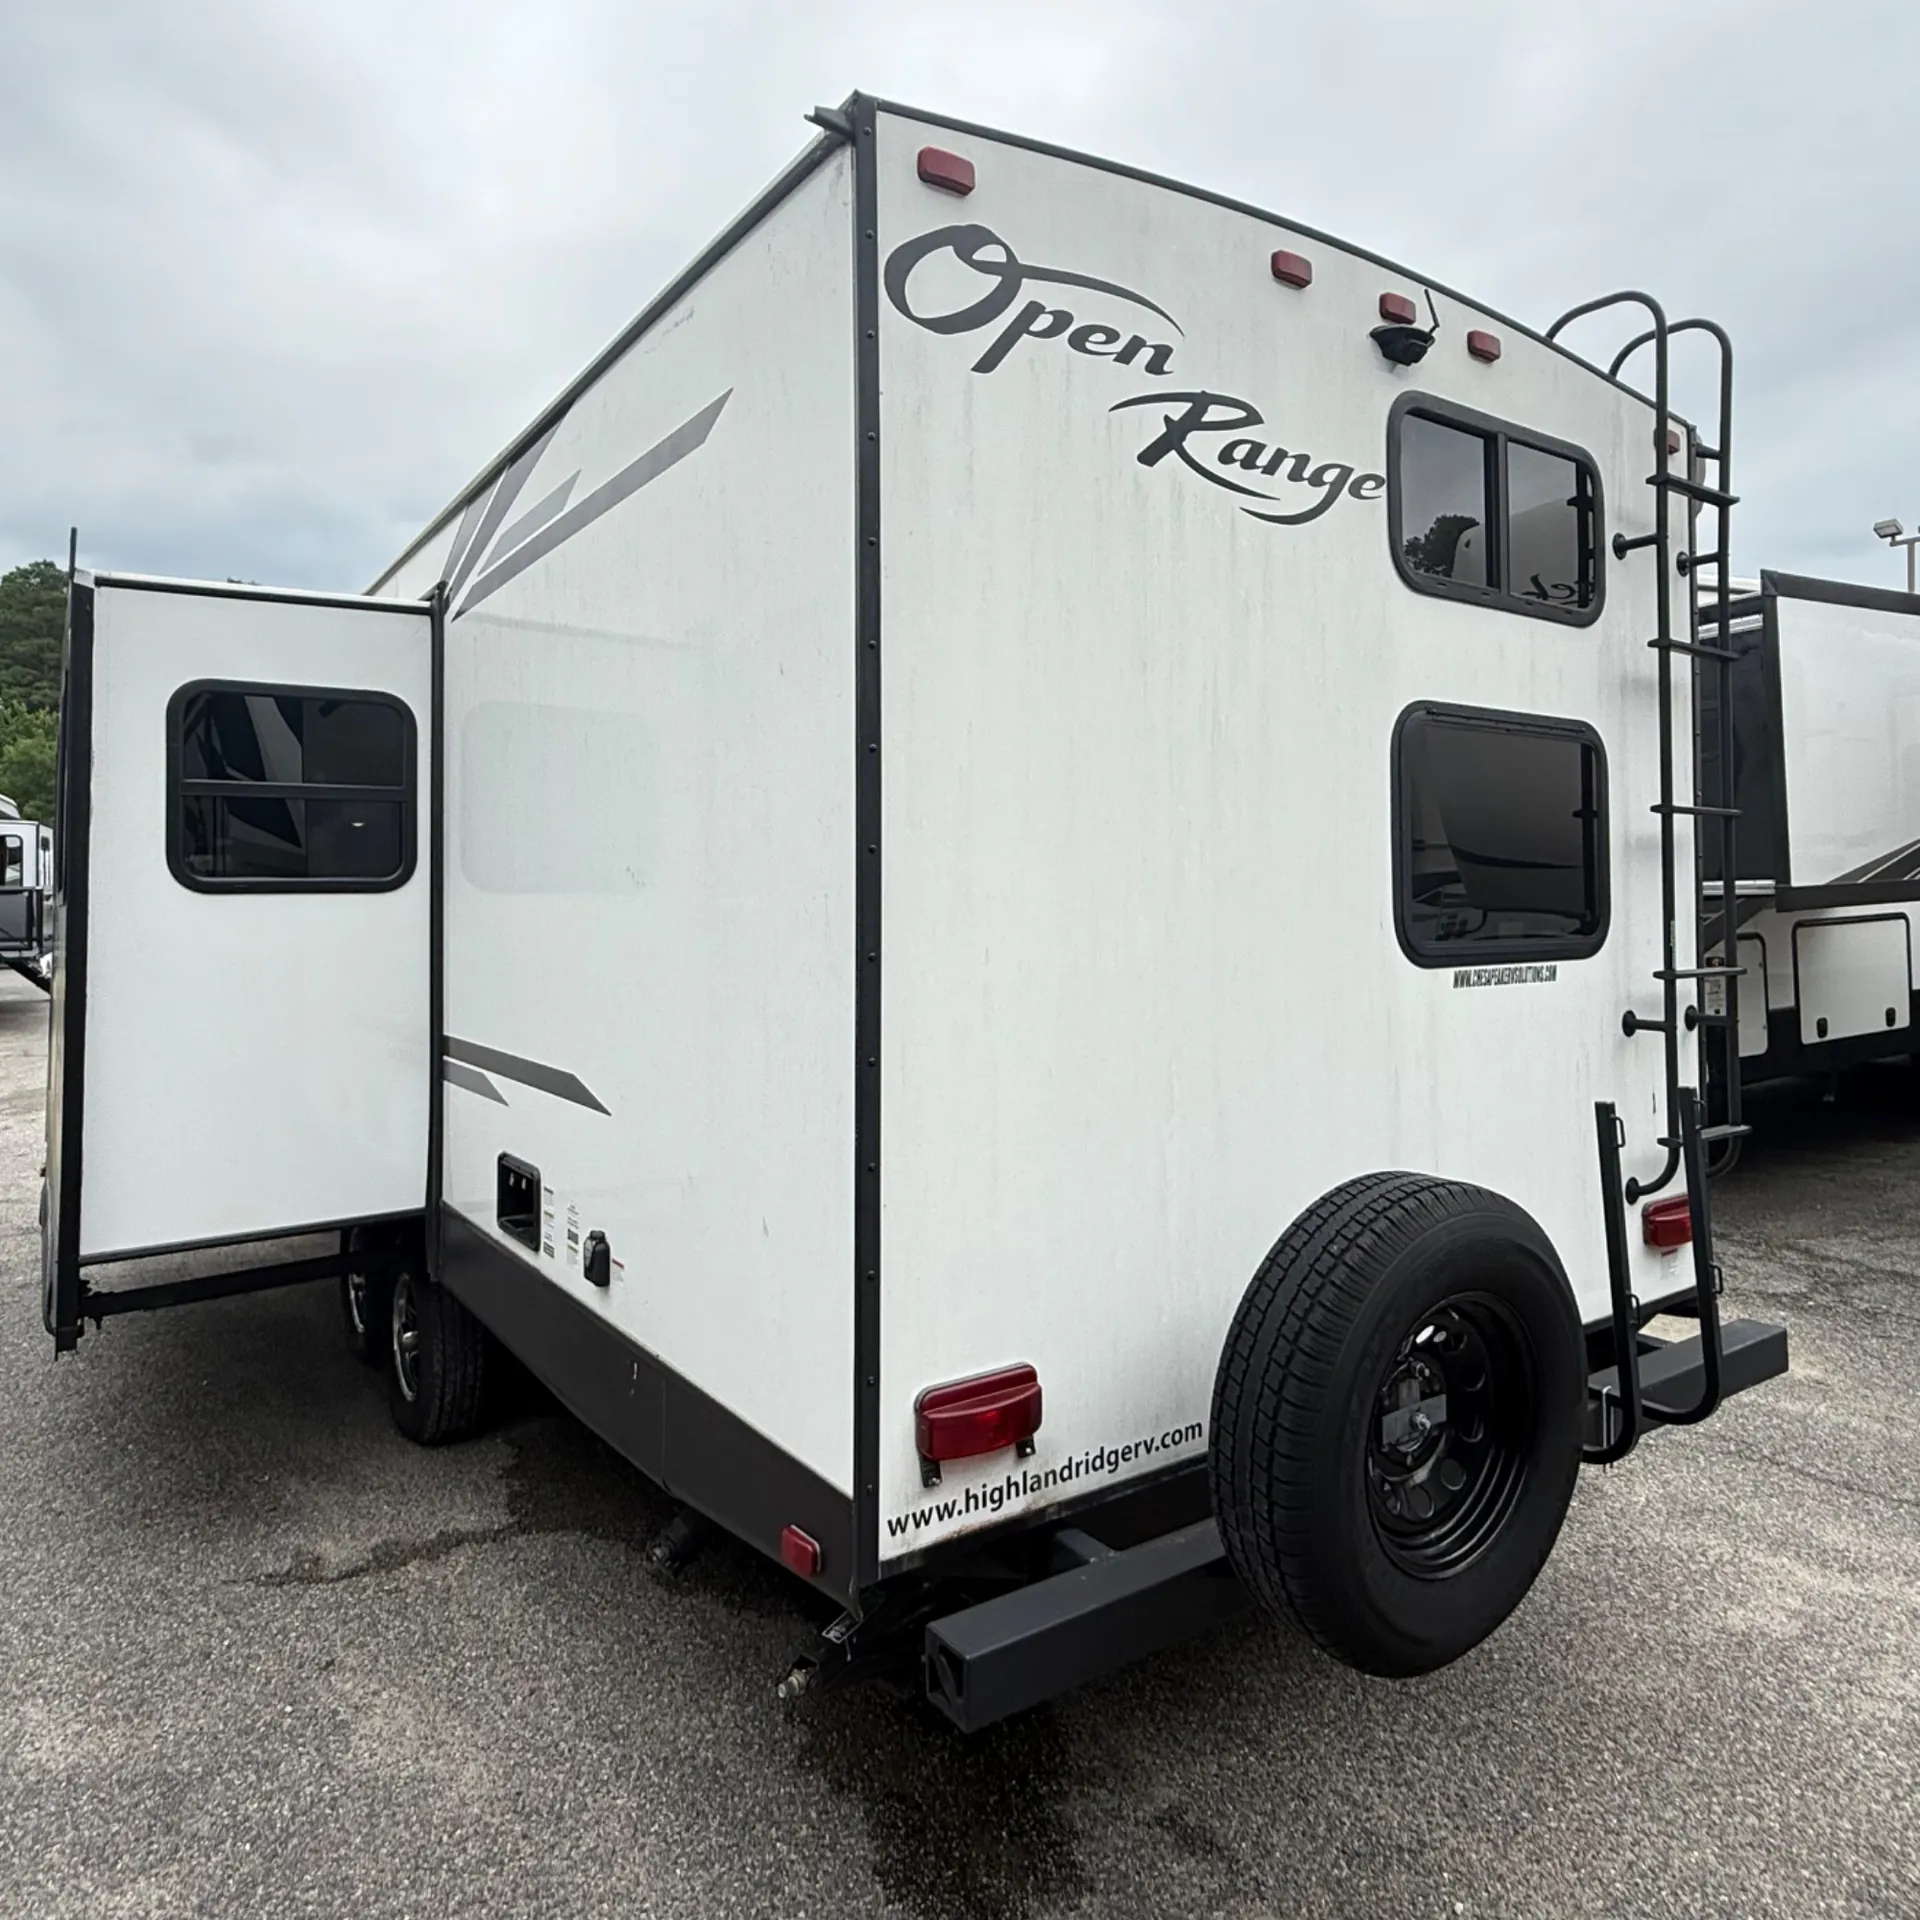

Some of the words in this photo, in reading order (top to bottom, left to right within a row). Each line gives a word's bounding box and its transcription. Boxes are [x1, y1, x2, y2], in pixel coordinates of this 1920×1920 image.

[884, 224, 1185, 376] Open
[1108, 390, 1386, 526] Range
[887, 1421, 1204, 1537] www.highlandridgerv.com
